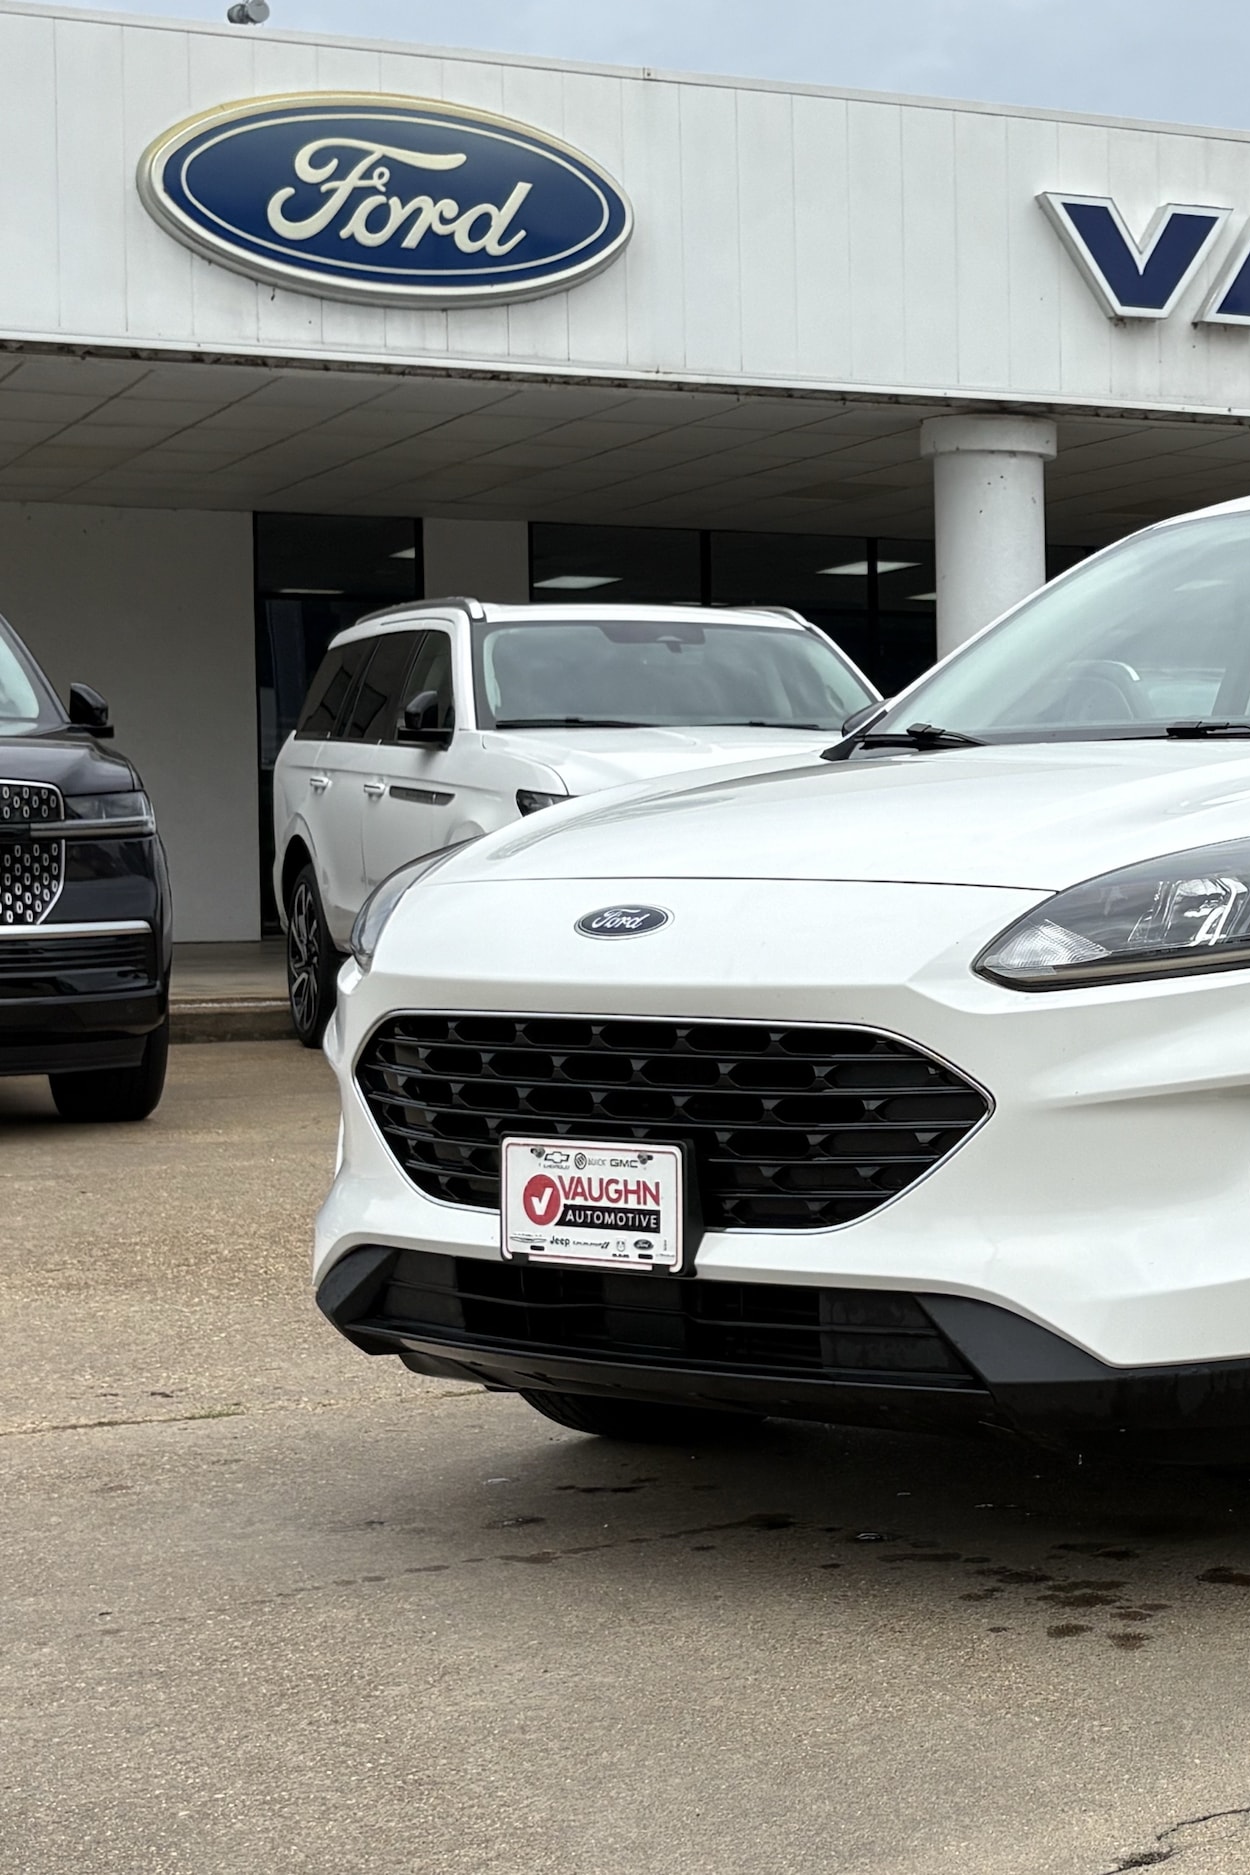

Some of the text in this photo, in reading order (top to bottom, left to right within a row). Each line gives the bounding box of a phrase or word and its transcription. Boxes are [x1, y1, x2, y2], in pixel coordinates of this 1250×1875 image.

[267, 137, 533, 256] Ford
[591, 908, 651, 929] Ford
[609, 1158, 639, 1168] GMC
[557, 1175, 660, 1207] VAUGHN
[565, 1209, 658, 1228] AUTOMOTIVE
[550, 1235, 570, 1247] Jeep
